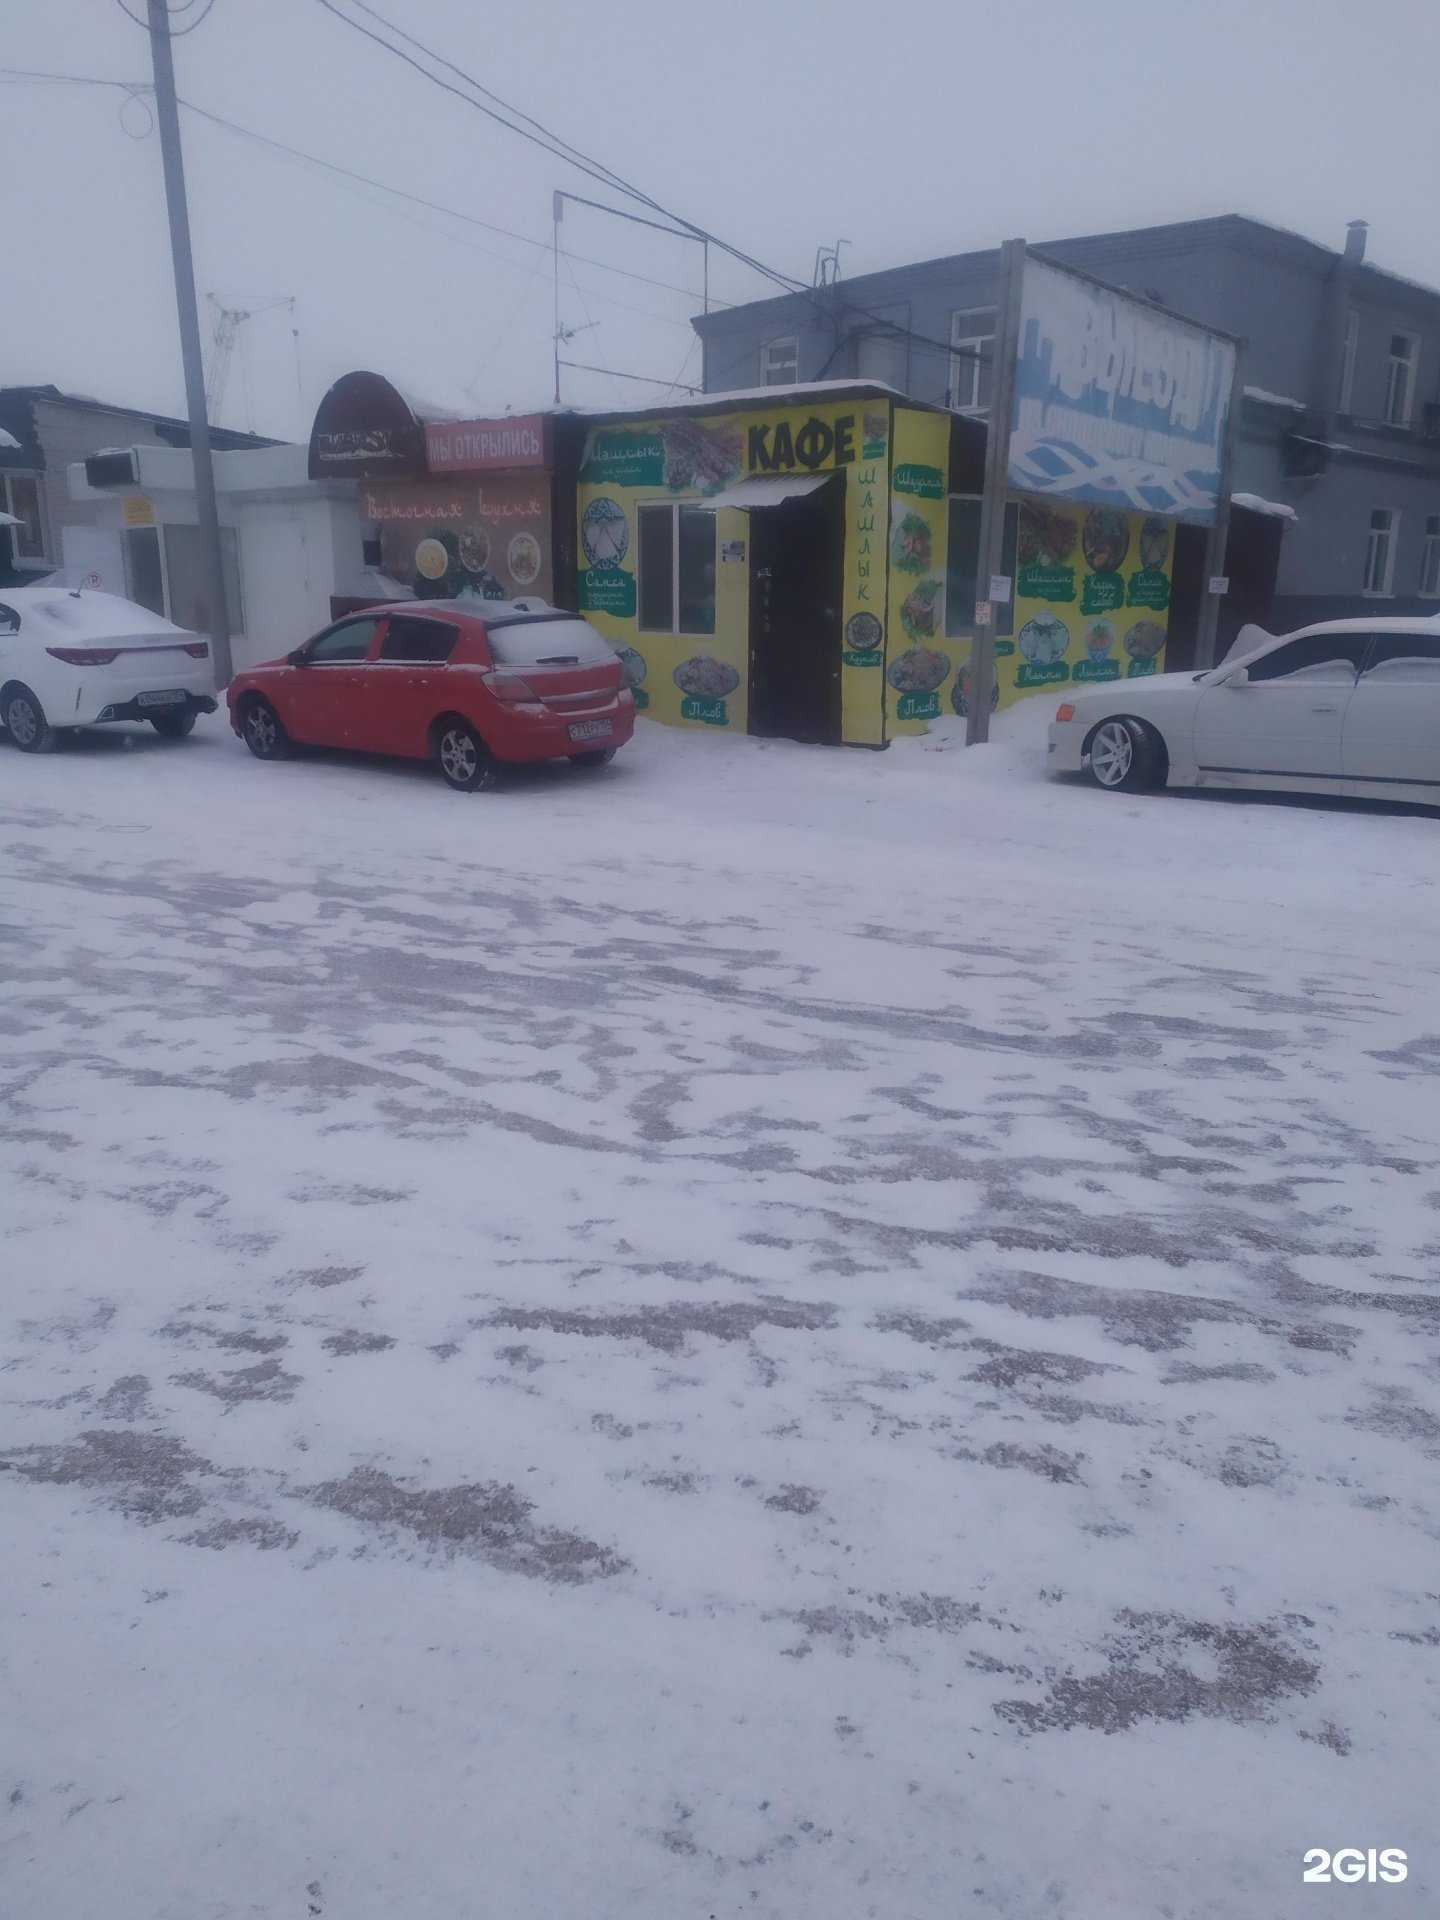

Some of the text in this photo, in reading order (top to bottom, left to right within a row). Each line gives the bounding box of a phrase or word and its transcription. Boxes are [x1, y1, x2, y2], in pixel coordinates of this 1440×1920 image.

[428, 437, 451, 464] МЫ
[457, 429, 539, 461] ОТКРЫЛИСЬ
[750, 416, 856, 471] КАФЕ
